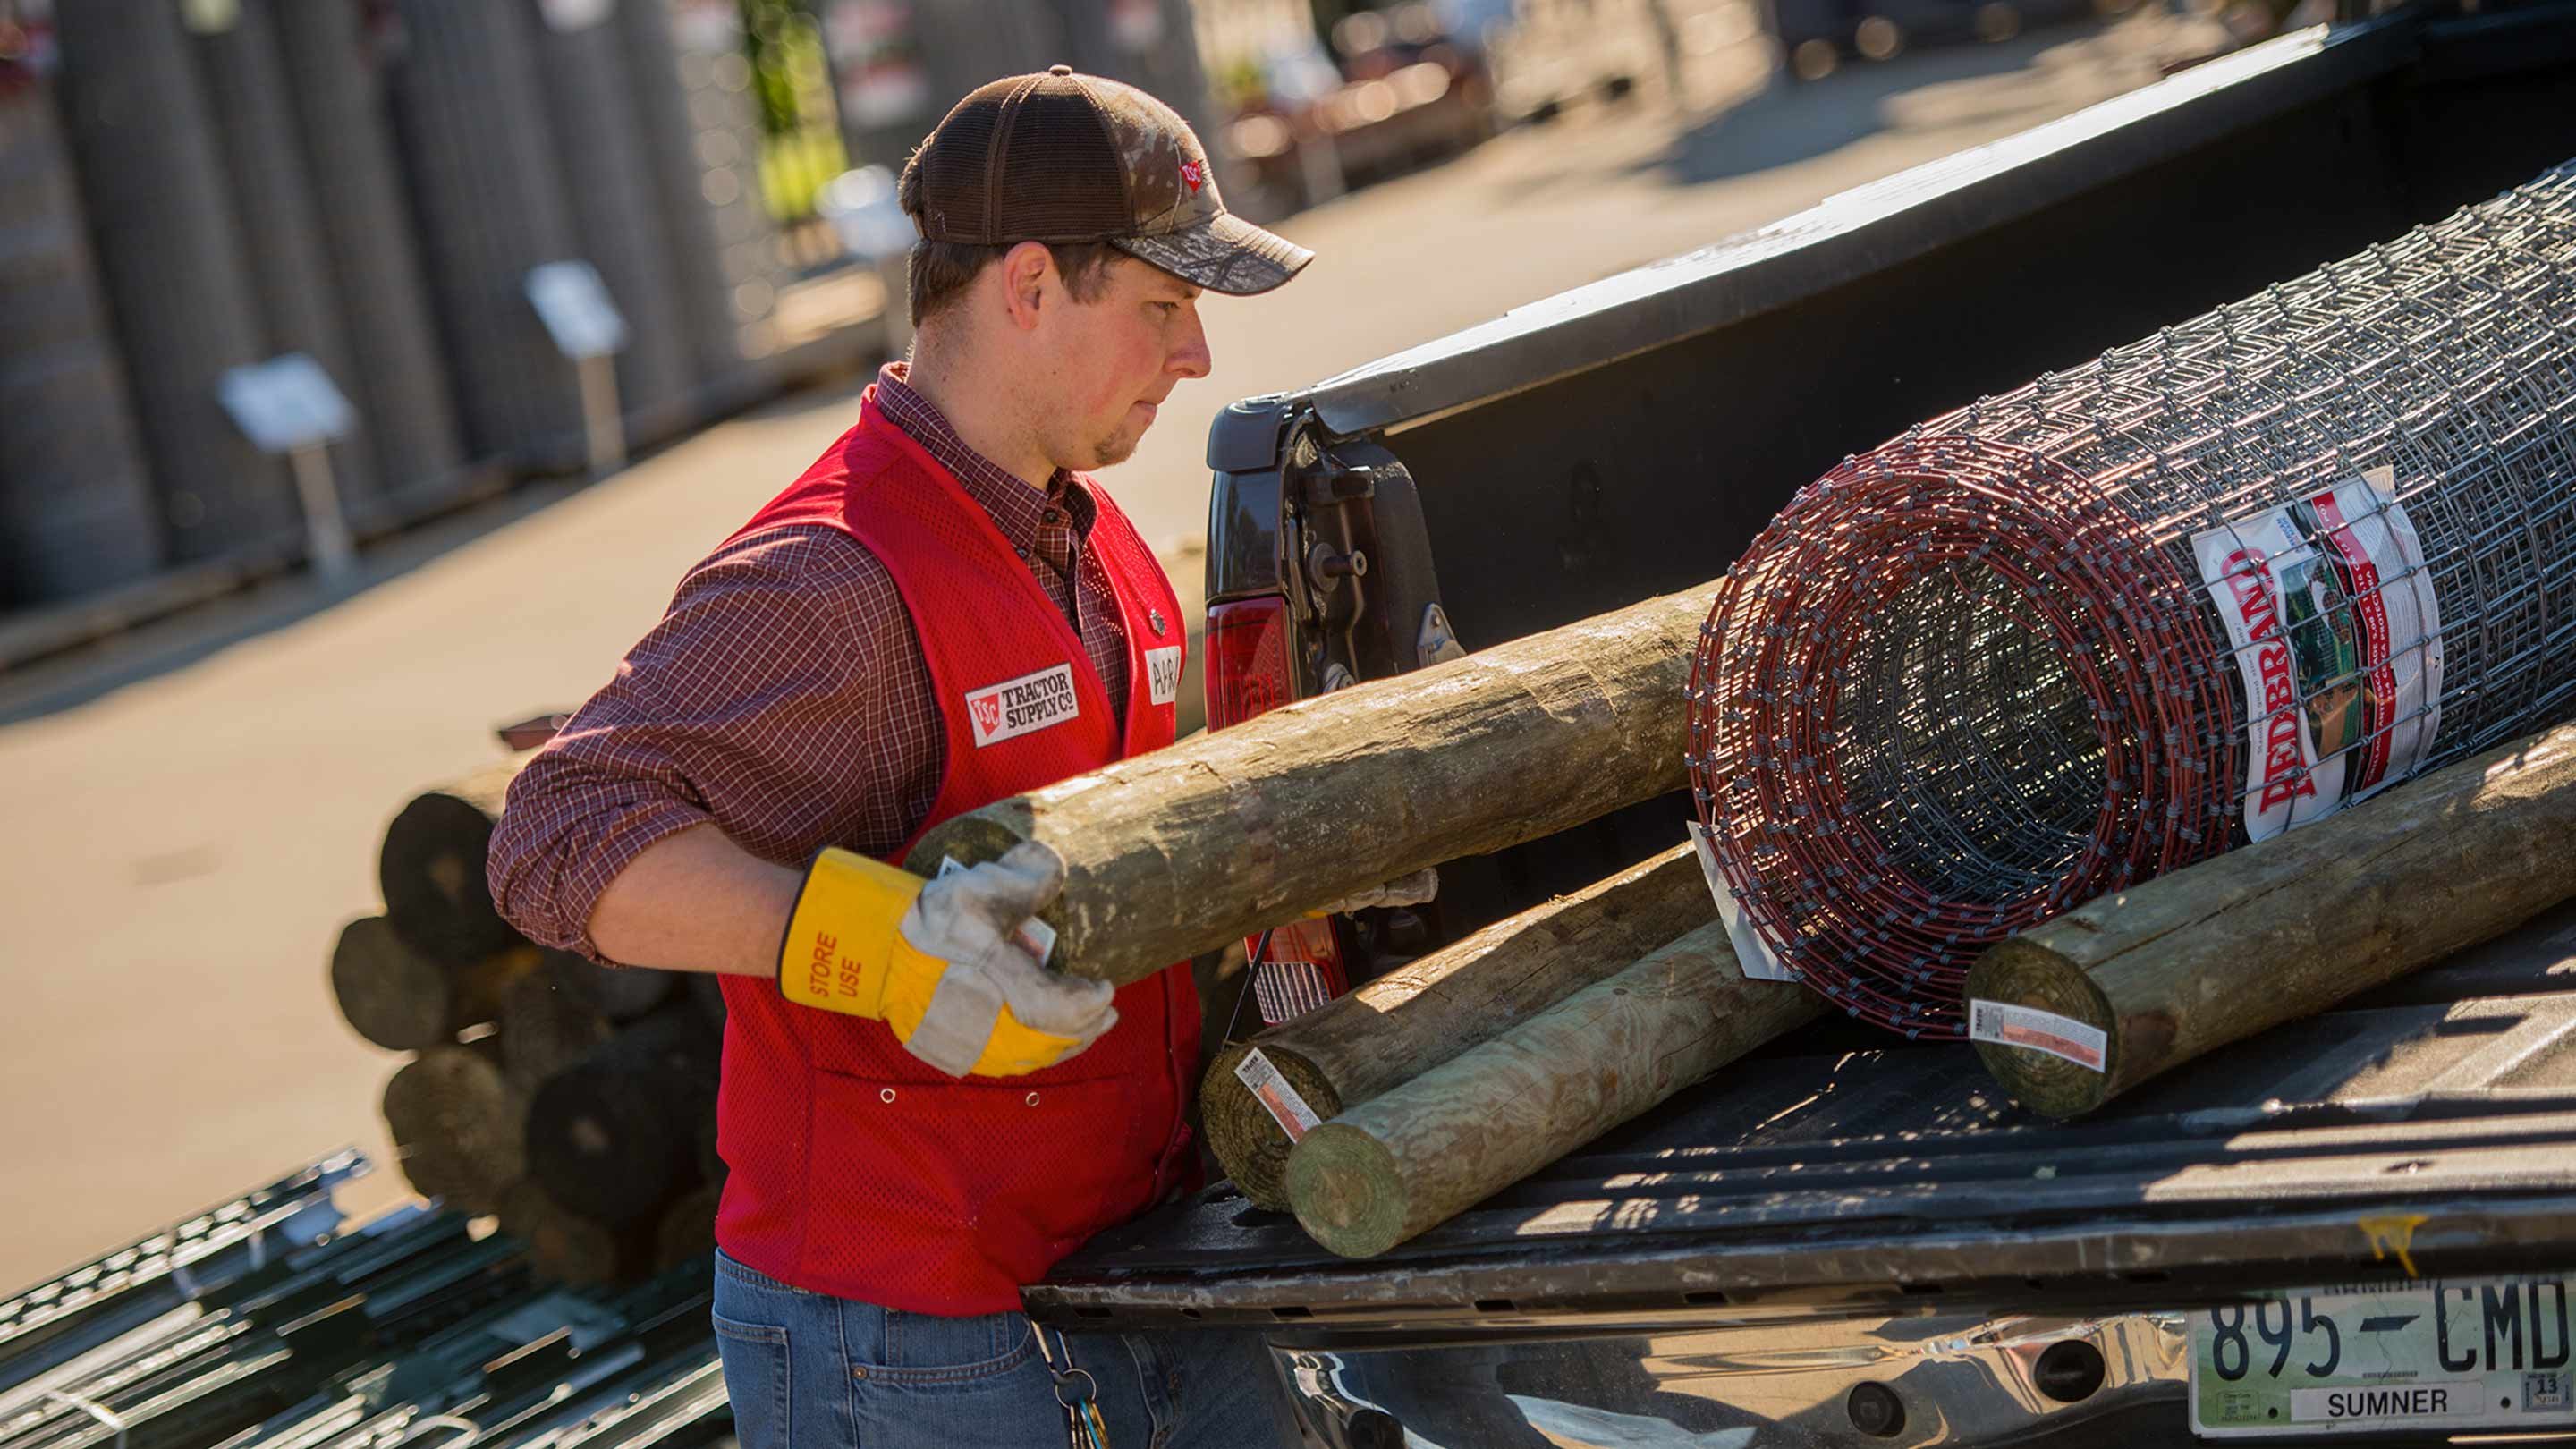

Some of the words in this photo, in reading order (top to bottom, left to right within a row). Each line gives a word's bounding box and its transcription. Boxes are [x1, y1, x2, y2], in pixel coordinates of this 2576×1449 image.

[2357, 573, 2368, 602] 1,16
[2380, 643, 2389, 679] CECA
[1002, 672, 1069, 708] TRACTOR
[973, 700, 998, 726] TSC
[1006, 696, 1057, 729] SUPPLY
[809, 931, 837, 997] STORE
[838, 957, 862, 997] USE
[2210, 1297, 2341, 1382] 895
[2434, 1280, 2570, 1372] CMD
[2328, 1388, 2448, 1418] SUMNER
[2537, 1378, 2558, 1394] 13
